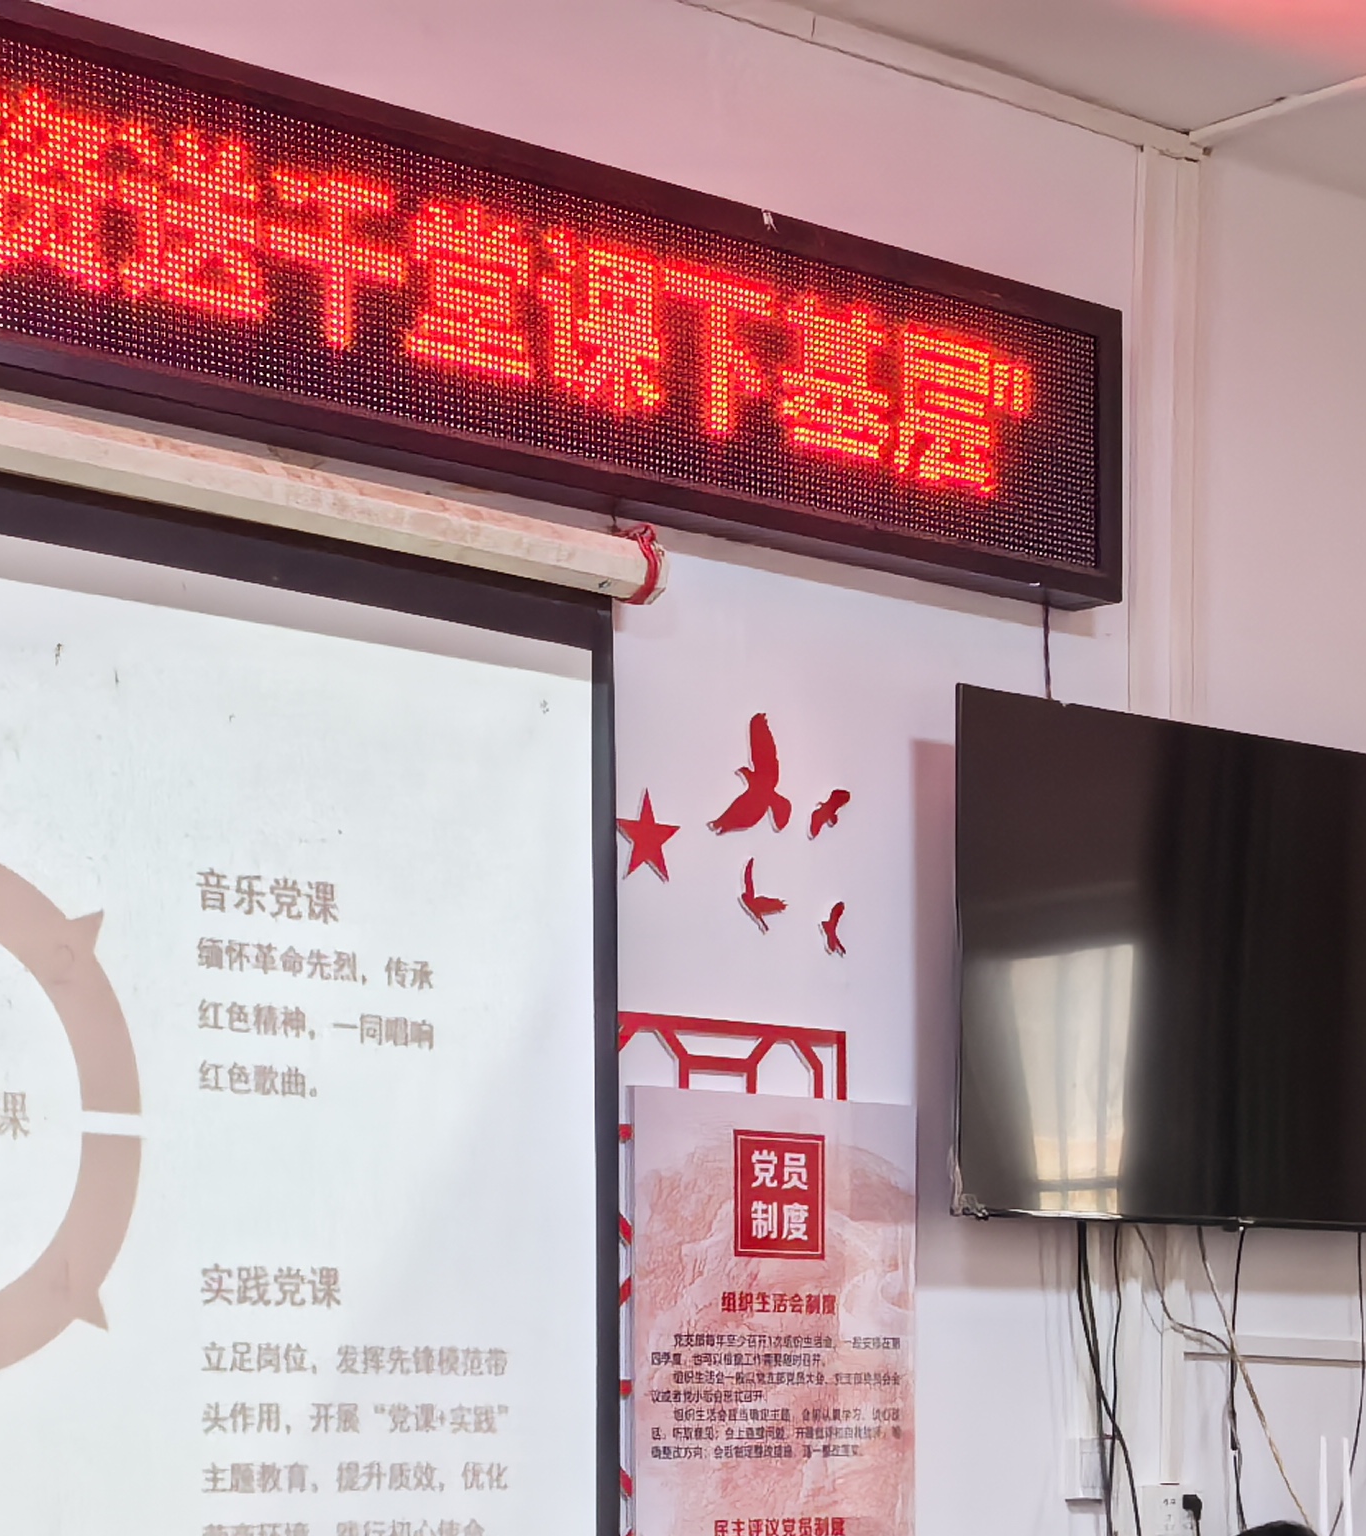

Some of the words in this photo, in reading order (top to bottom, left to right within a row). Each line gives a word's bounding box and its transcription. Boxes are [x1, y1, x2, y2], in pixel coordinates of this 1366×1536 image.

[195, 867, 340, 925] 音乐党课
[197, 1059, 321, 1102] 红色歌曲。
[750, 1148, 809, 1190] 党员
[750, 1201, 809, 1241] 制度
[199, 1265, 343, 1309] 实践党课
[720, 1291, 838, 1316] 组织生活会制度
